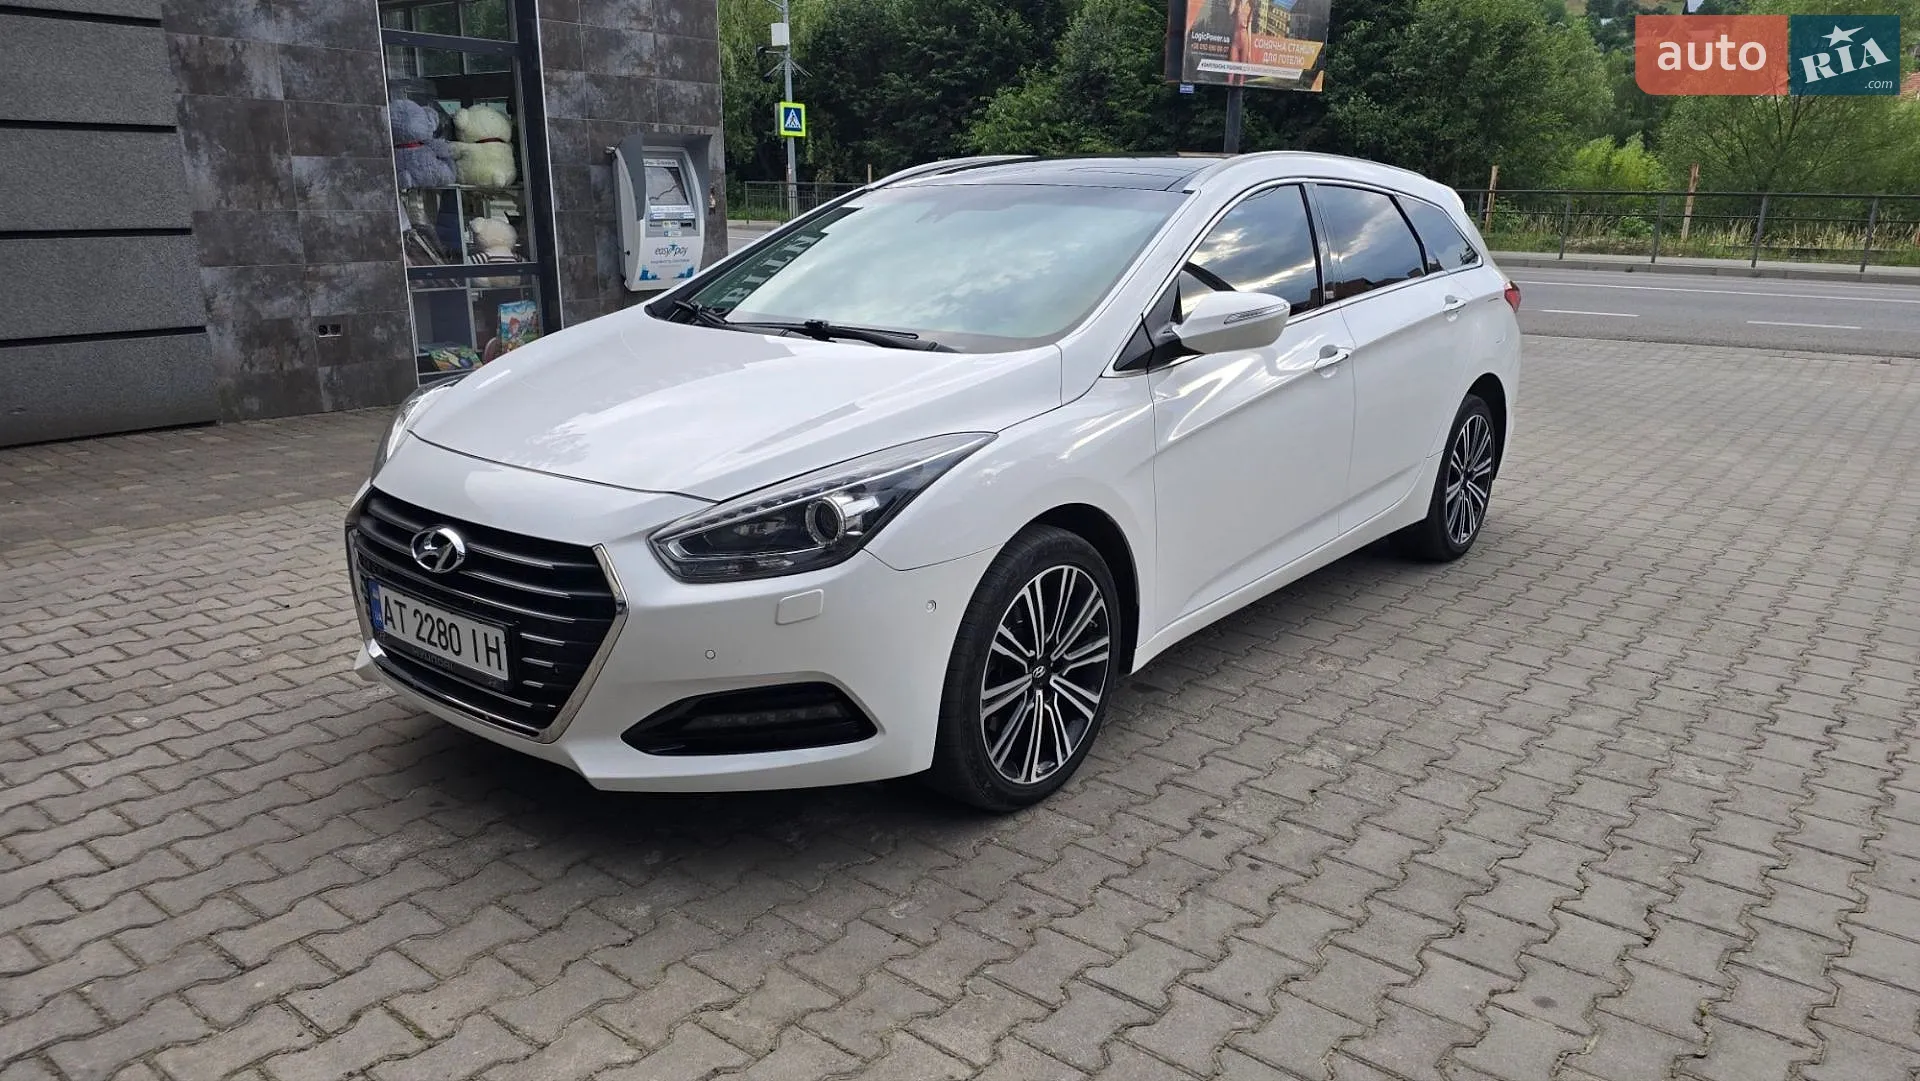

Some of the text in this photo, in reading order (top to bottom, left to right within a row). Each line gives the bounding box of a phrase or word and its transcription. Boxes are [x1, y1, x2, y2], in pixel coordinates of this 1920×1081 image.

[1287, 43, 1315, 55] СТАН
[384, 595, 407, 634] AT
[413, 608, 461, 656] 2280
